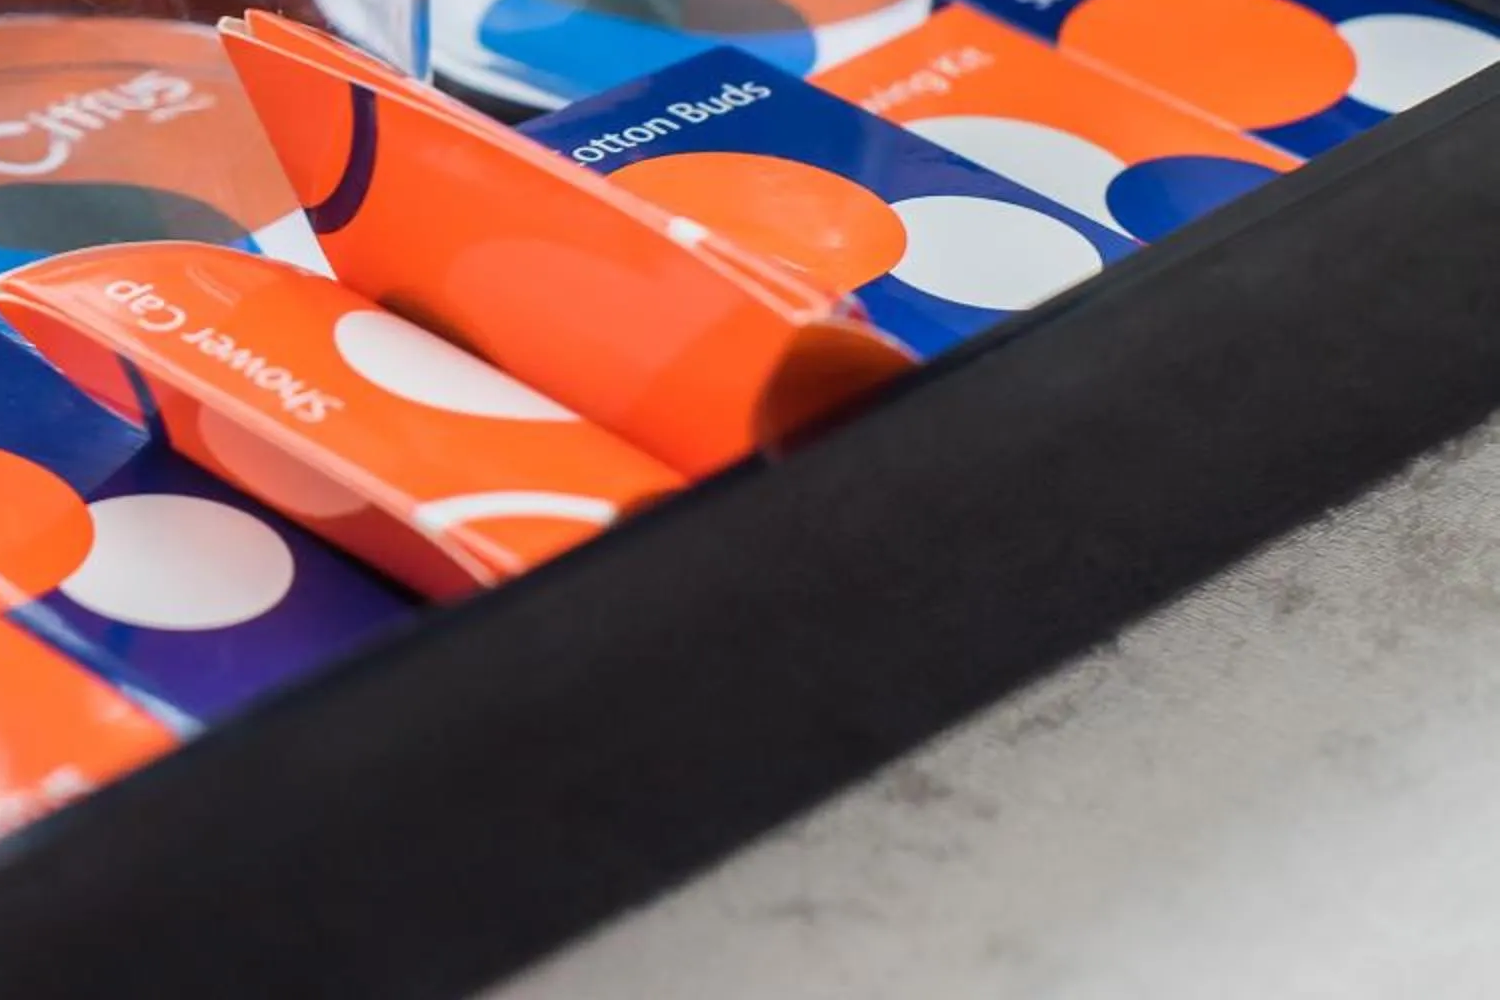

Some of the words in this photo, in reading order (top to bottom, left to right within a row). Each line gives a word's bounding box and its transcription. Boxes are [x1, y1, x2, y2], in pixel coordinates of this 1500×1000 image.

[571, 116, 682, 167] otton
[666, 81, 772, 124] Buds
[103, 279, 187, 332] Cap
[180, 326, 346, 424] Shower
